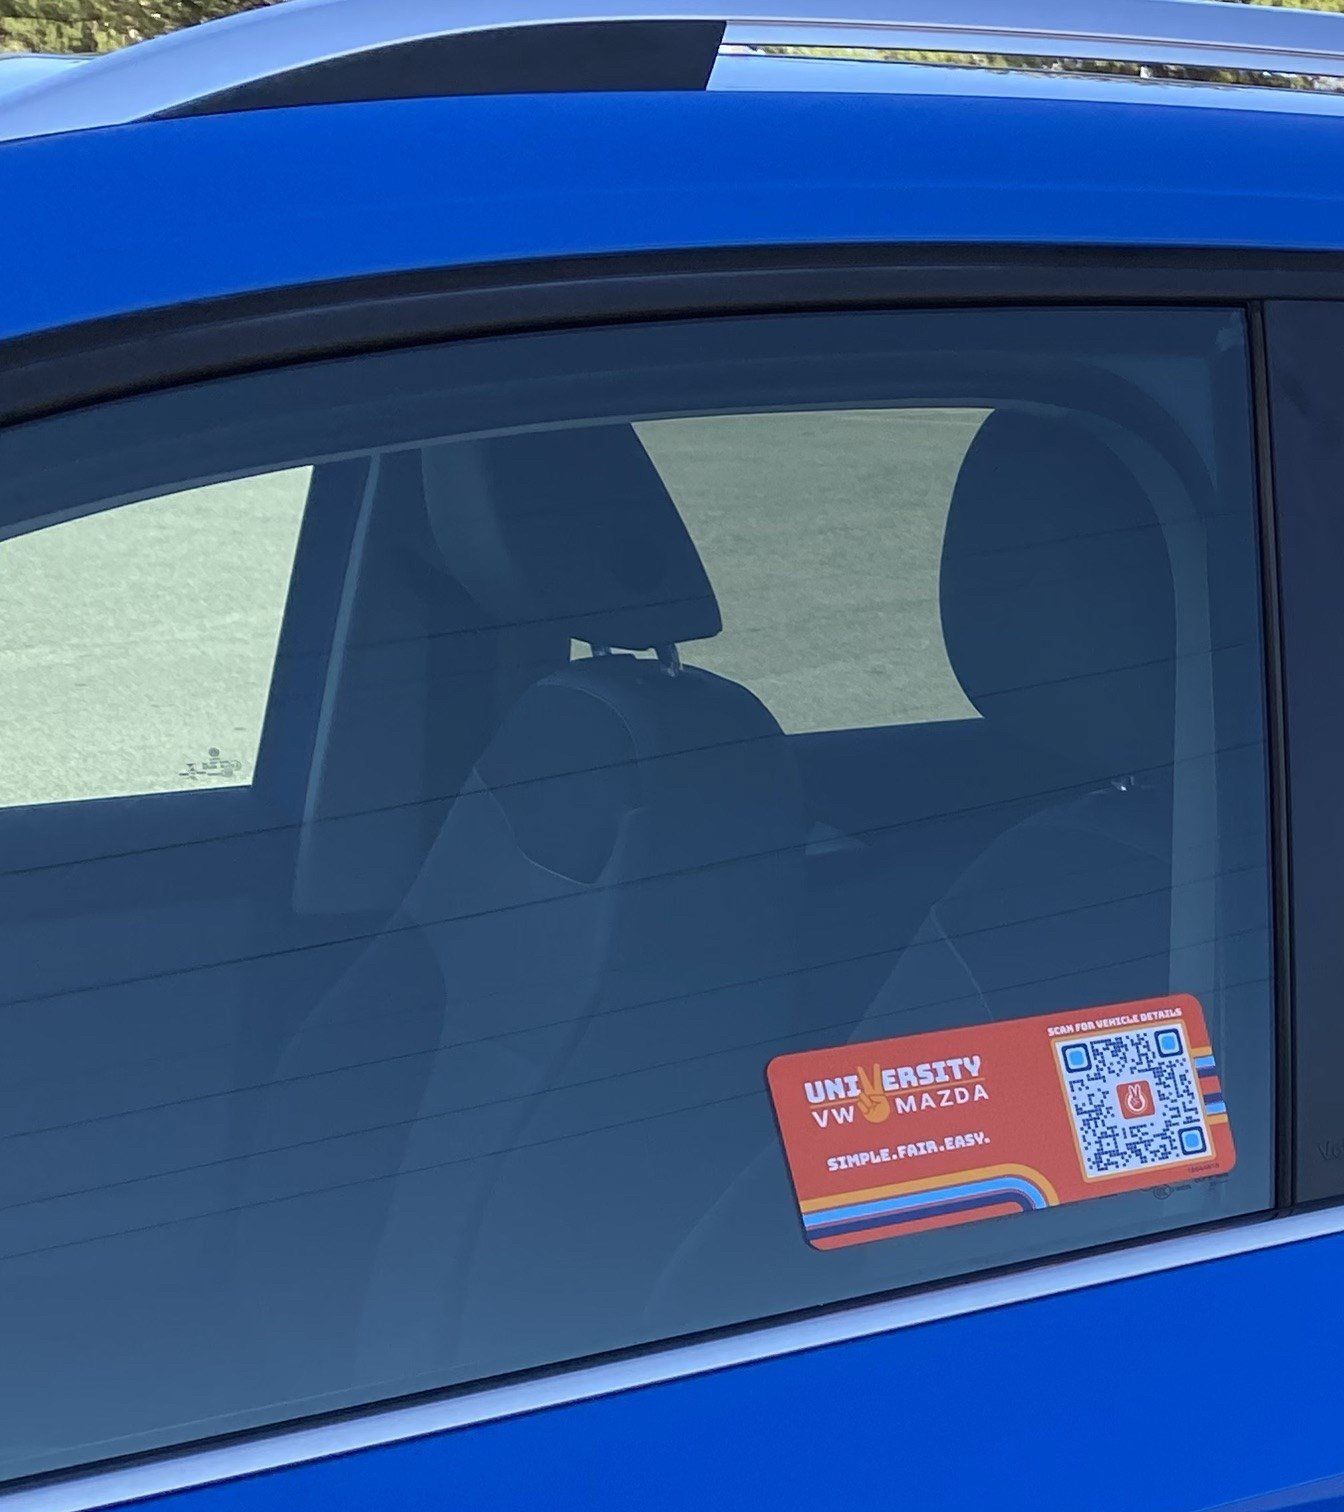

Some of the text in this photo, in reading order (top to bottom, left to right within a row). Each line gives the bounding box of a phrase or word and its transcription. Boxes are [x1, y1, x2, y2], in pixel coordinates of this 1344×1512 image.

[1047, 1007, 1182, 1036] SCAN FOR VEHICLE DETAILS
[811, 1084, 989, 1128] VW MAZDA
